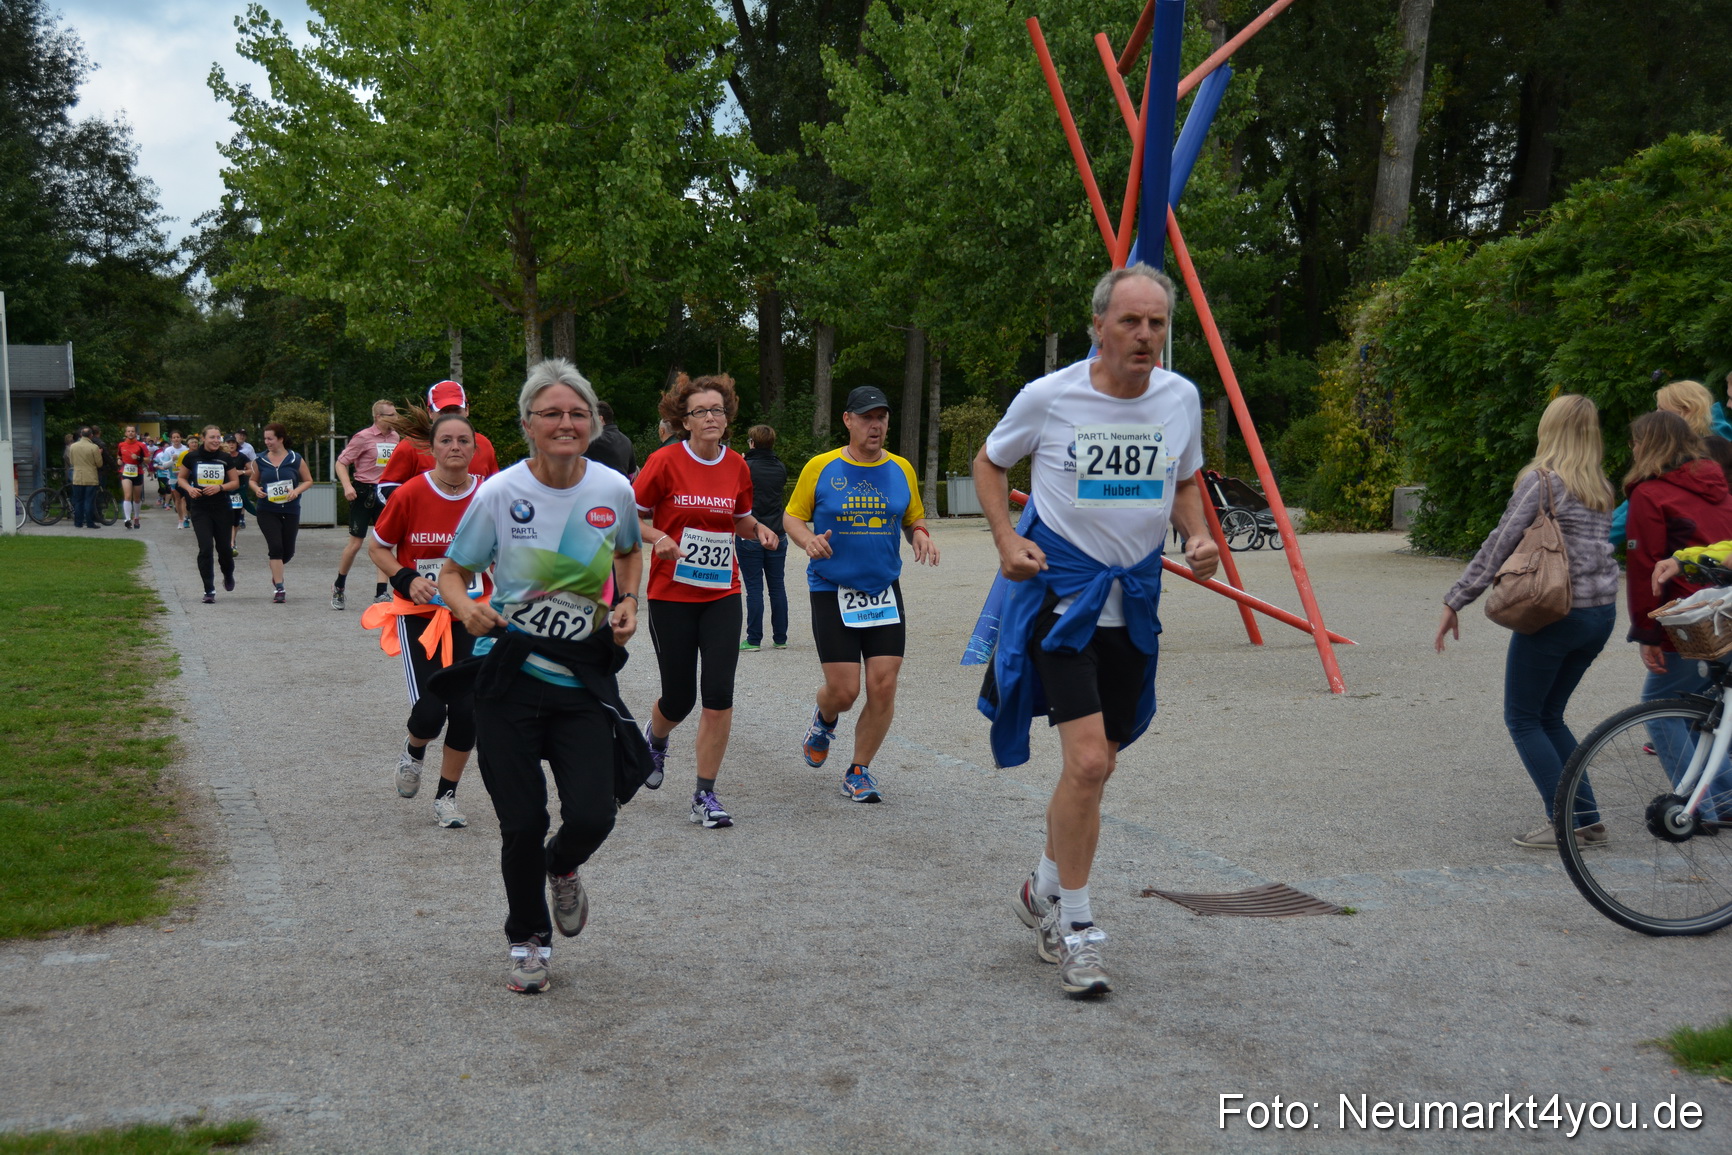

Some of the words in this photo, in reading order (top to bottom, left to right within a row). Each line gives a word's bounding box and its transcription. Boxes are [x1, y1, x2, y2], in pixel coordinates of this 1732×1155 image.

[1078, 432, 1109, 441] PARTL
[1110, 432, 1151, 441] Neumarkt
[382, 448, 394, 458] 36
[1086, 444, 1159, 476] 2487
[203, 469, 220, 479] 385
[272, 486, 289, 496] 384
[1103, 484, 1141, 497] Hubert
[511, 527, 538, 535] PARTL
[411, 532, 456, 543] NEUMA
[683, 532, 705, 542] PARTL
[685, 542, 731, 567] 2332
[692, 569, 719, 580] Kerstin
[511, 602, 587, 640] 2462
